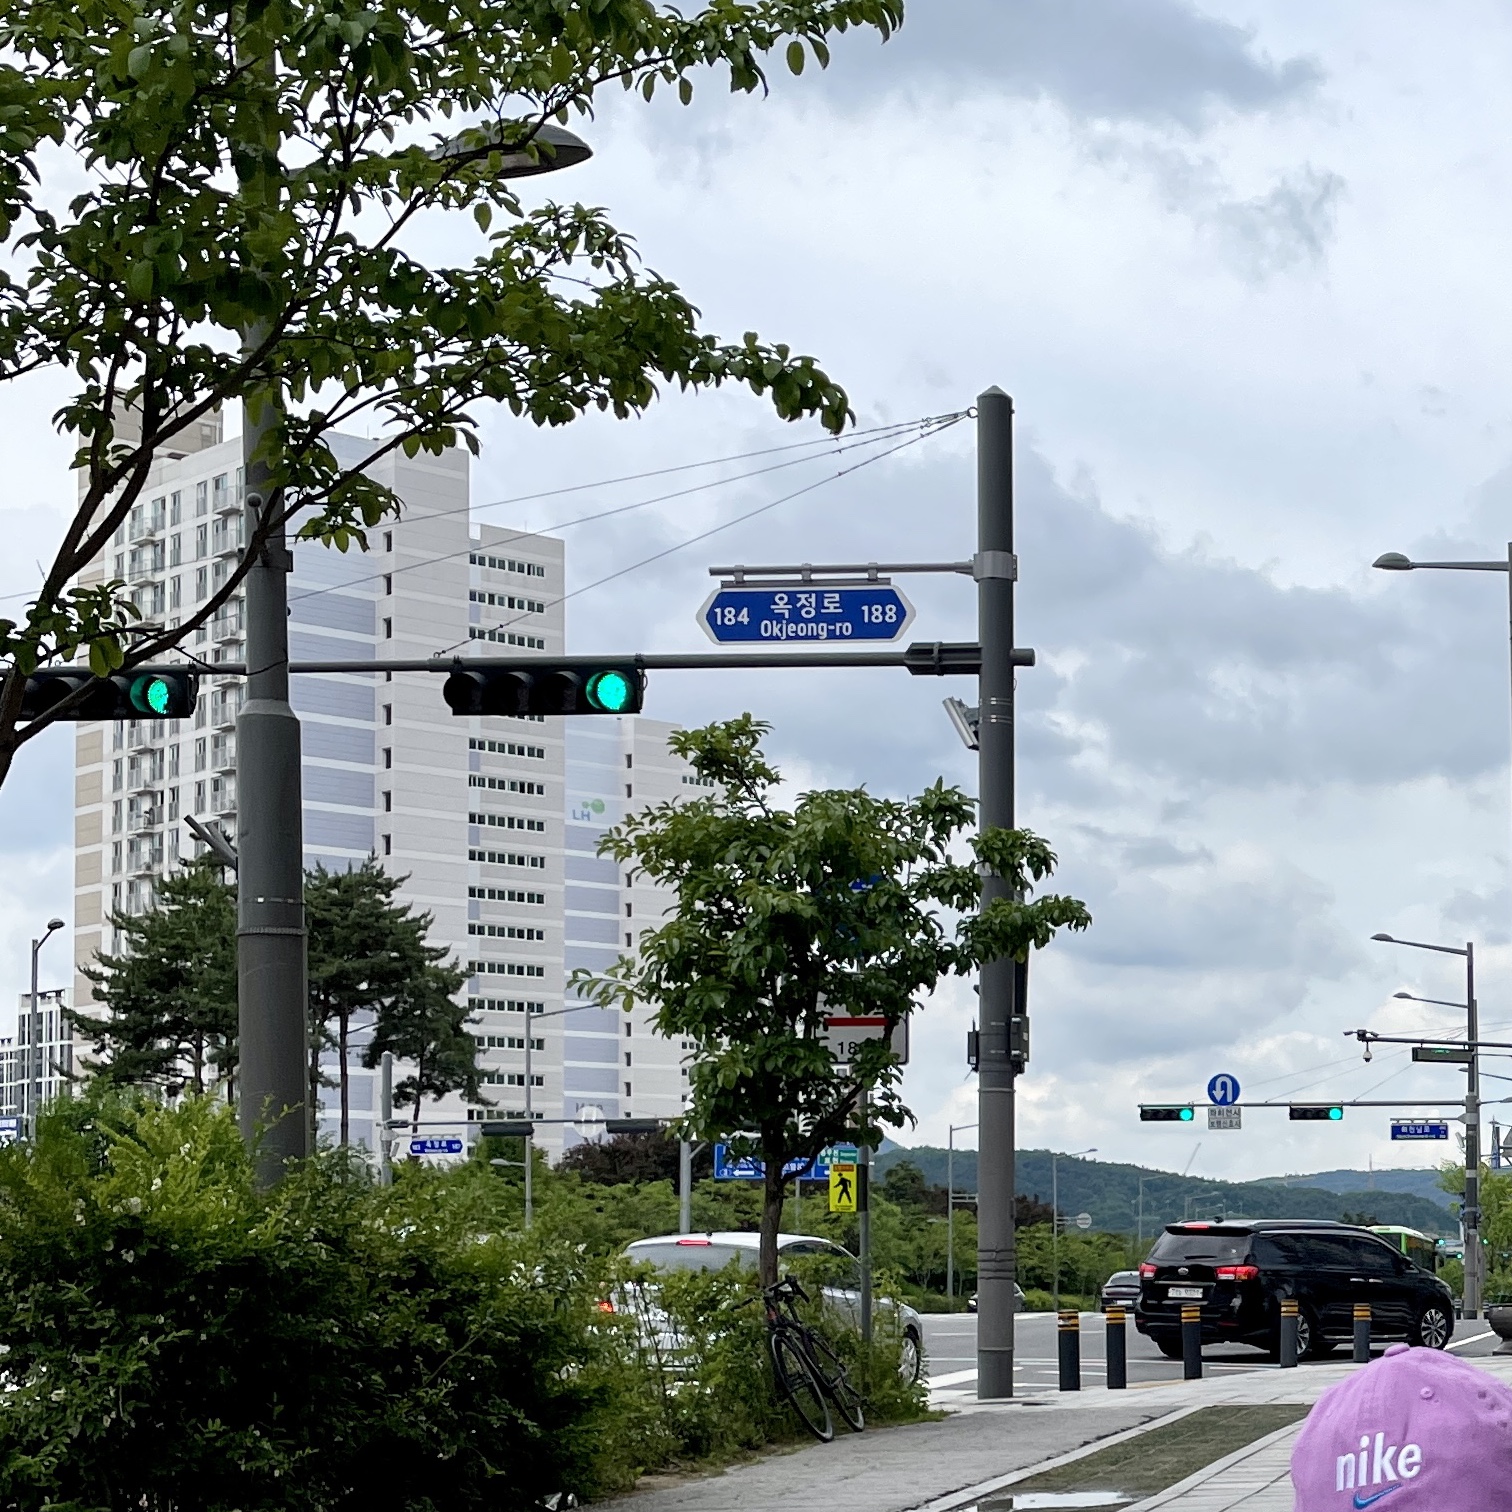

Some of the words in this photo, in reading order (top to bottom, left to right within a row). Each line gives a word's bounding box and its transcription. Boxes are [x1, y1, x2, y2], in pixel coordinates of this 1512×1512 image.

[770, 592, 843, 619] 옥정로
[862, 603, 897, 624] 188
[714, 607, 750, 626] 184
[760, 619, 852, 640] Okjeong-ro
[572, 809, 601, 821] LH
[1335, 1432, 1423, 1492] nike
